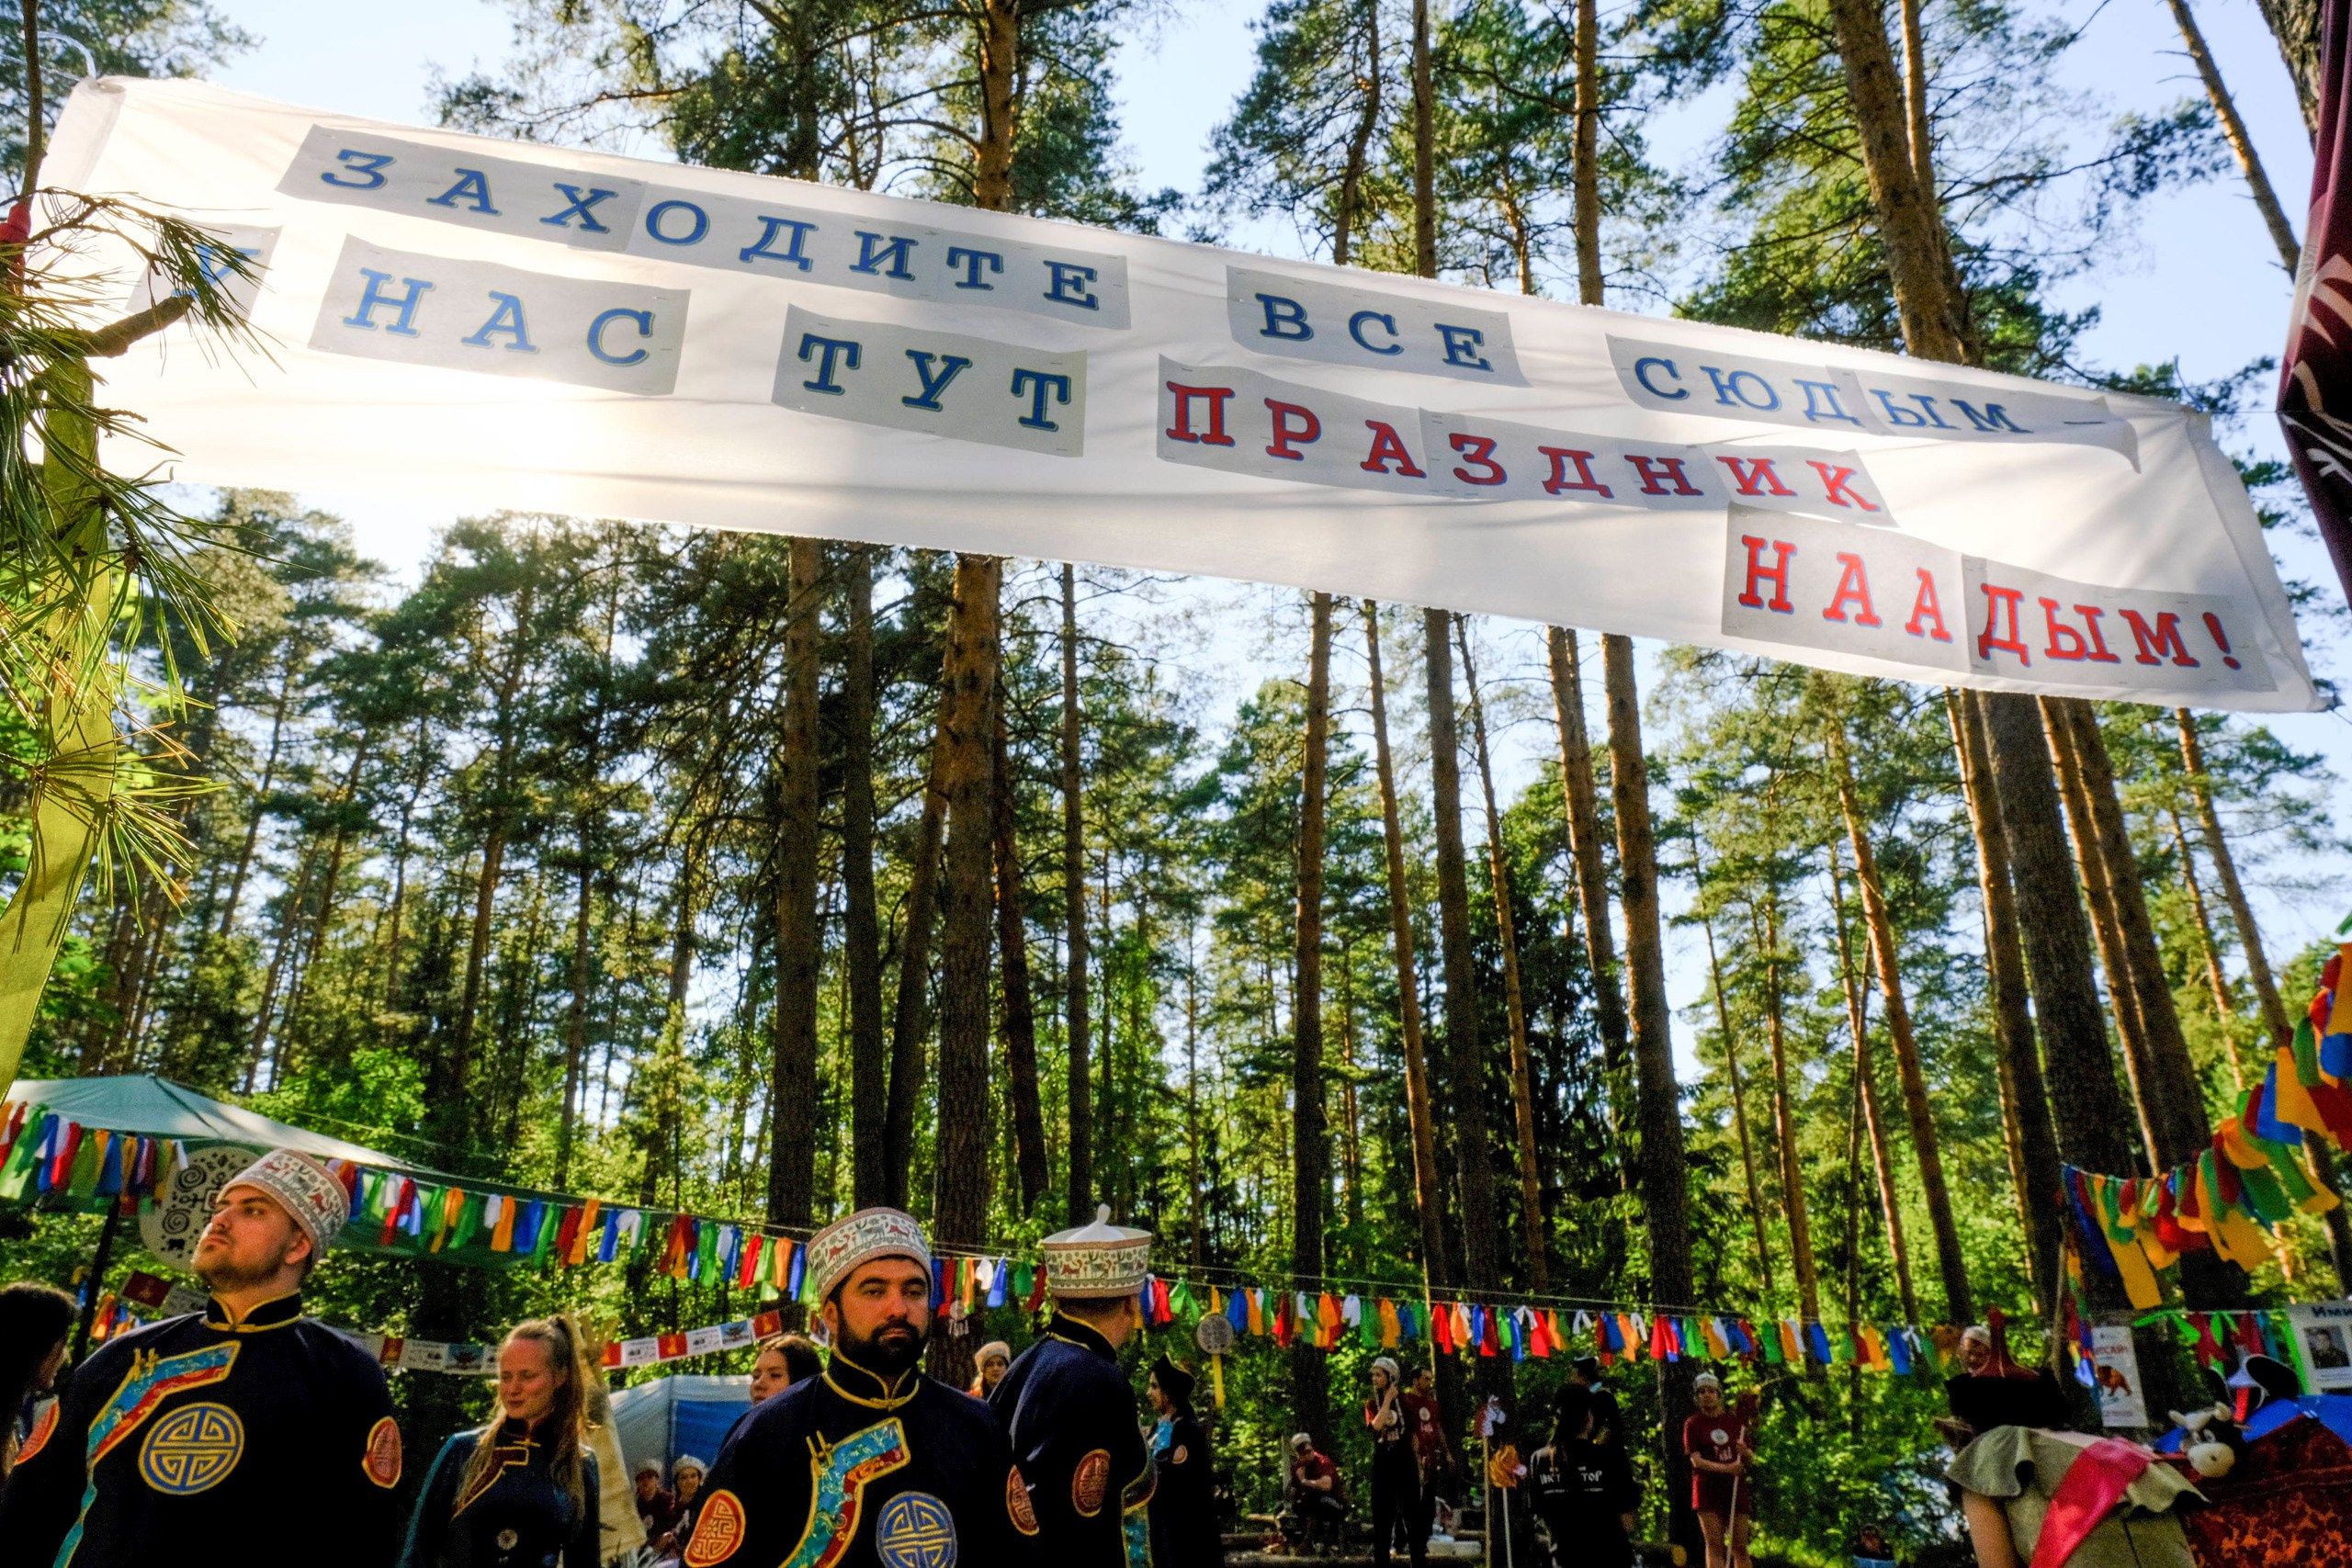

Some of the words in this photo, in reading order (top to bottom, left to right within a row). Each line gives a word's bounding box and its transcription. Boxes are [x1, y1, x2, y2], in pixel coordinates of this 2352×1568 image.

[321, 148, 1100, 310] ЗАХОДИТЕ
[1255, 292, 1494, 373] ВСЕ
[1634, 356, 2034, 434] СЮДЫМ
[343, 267, 656, 367] НАС
[797, 333, 1072, 433] ТУТ
[1165, 381, 1882, 514] ПРАЗДНИК
[1738, 534, 2242, 671] НААДЫМ!
